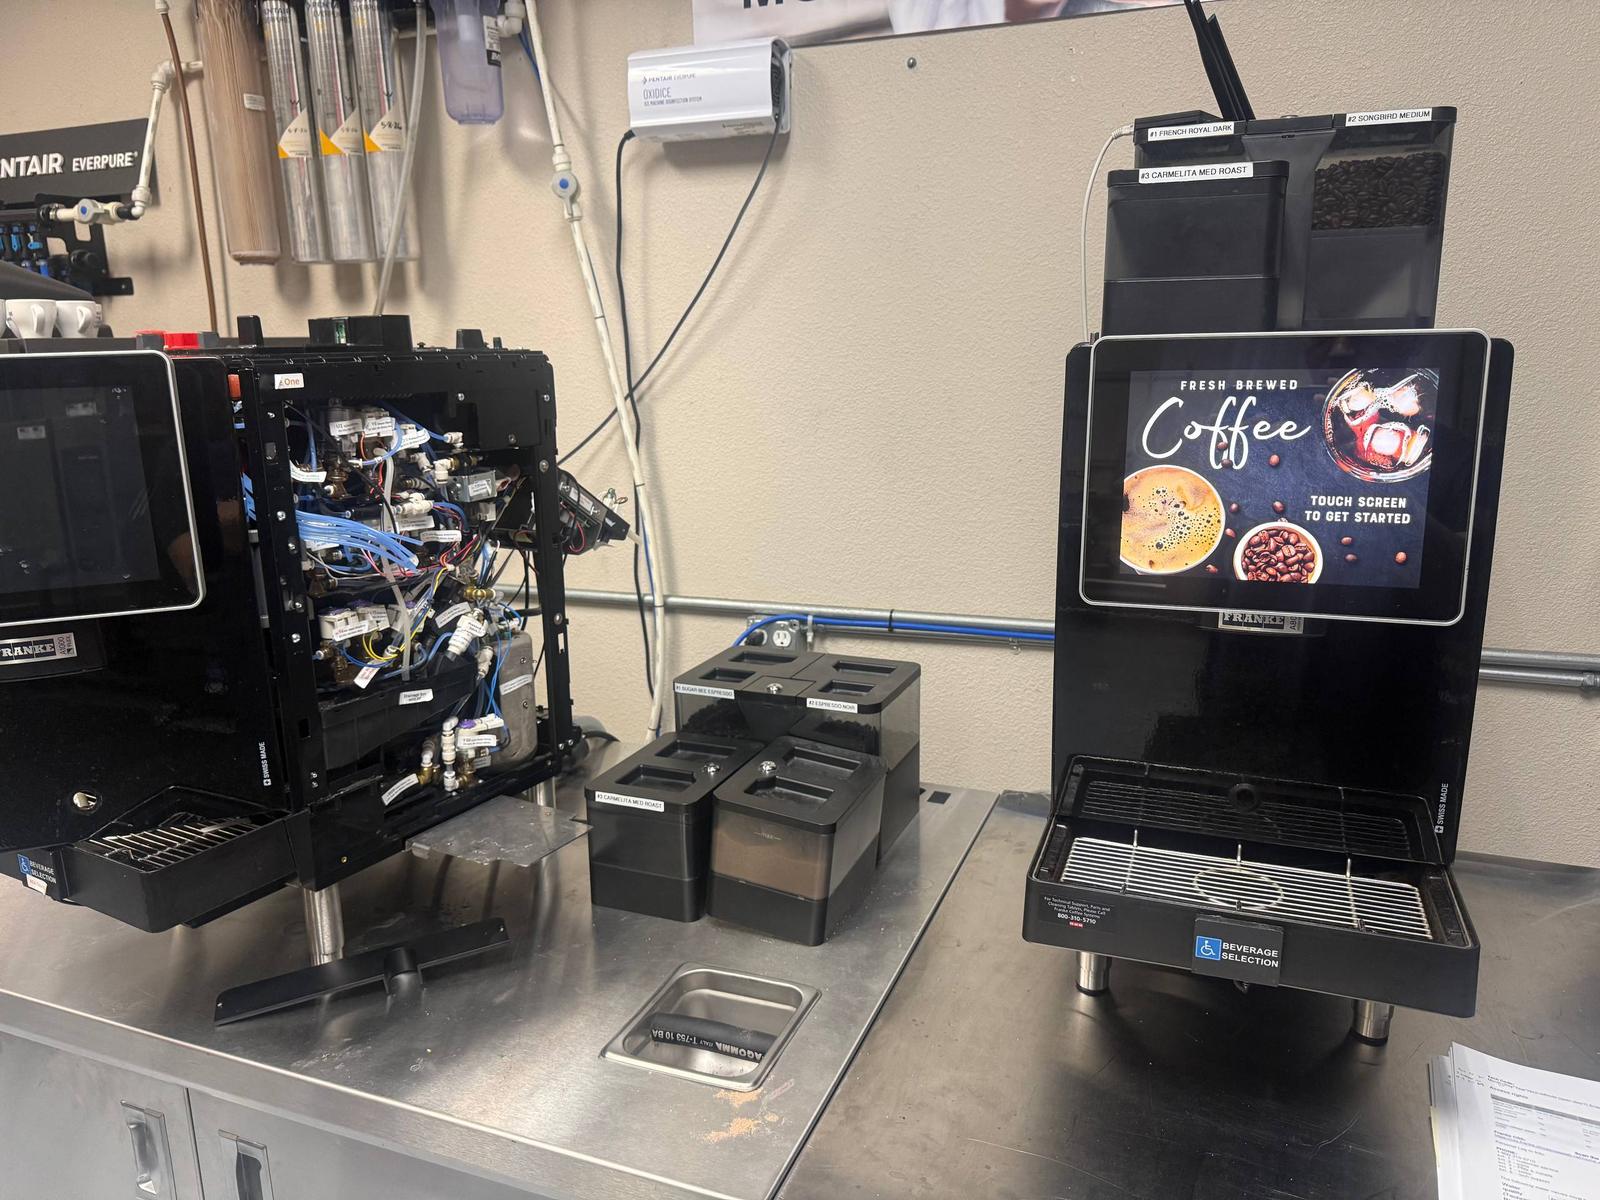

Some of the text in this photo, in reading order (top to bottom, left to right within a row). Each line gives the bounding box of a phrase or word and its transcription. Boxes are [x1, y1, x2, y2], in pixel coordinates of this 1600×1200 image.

[643, 87, 672, 99] OXIDICE
[1358, 113, 1398, 122] SONGBIRD
[1399, 110, 1430, 119] MEDIUM
[1159, 128, 1187, 137] FRENCH
[1188, 126, 1211, 134] ROYAL
[1212, 124, 1232, 132] DARK
[1141, 166, 1248, 180] #3 CARMELITA MED ROAST
[1180, 379, 1298, 391] FRESH BREWED
[1141, 396, 1311, 469] Coffee
[1310, 495, 1407, 509] TOUCH SCREEN
[1304, 510, 1411, 524] TO GET STARTED
[1223, 612, 1284, 625] FRANKE
[0, 643, 55, 657] RANKE
[258, 741, 270, 779] SWISS MADE
[603, 794, 632, 804] CARMELITA
[644, 801, 662, 809] ROAST
[1437, 783, 1449, 825] SWISS MADE
[1047, 901, 1067, 909] Cleaning
[1052, 897, 1071, 905] Technical
[1057, 913, 1097, 924] 800-310-5710
[1222, 942, 1279, 958] BEVERAGE
[1221, 952, 1279, 968] SELECTION
[652, 1029, 664, 1038] BA
[665, 1031, 675, 1040] 10
[715, 1041, 764, 1061] AGOMMA
